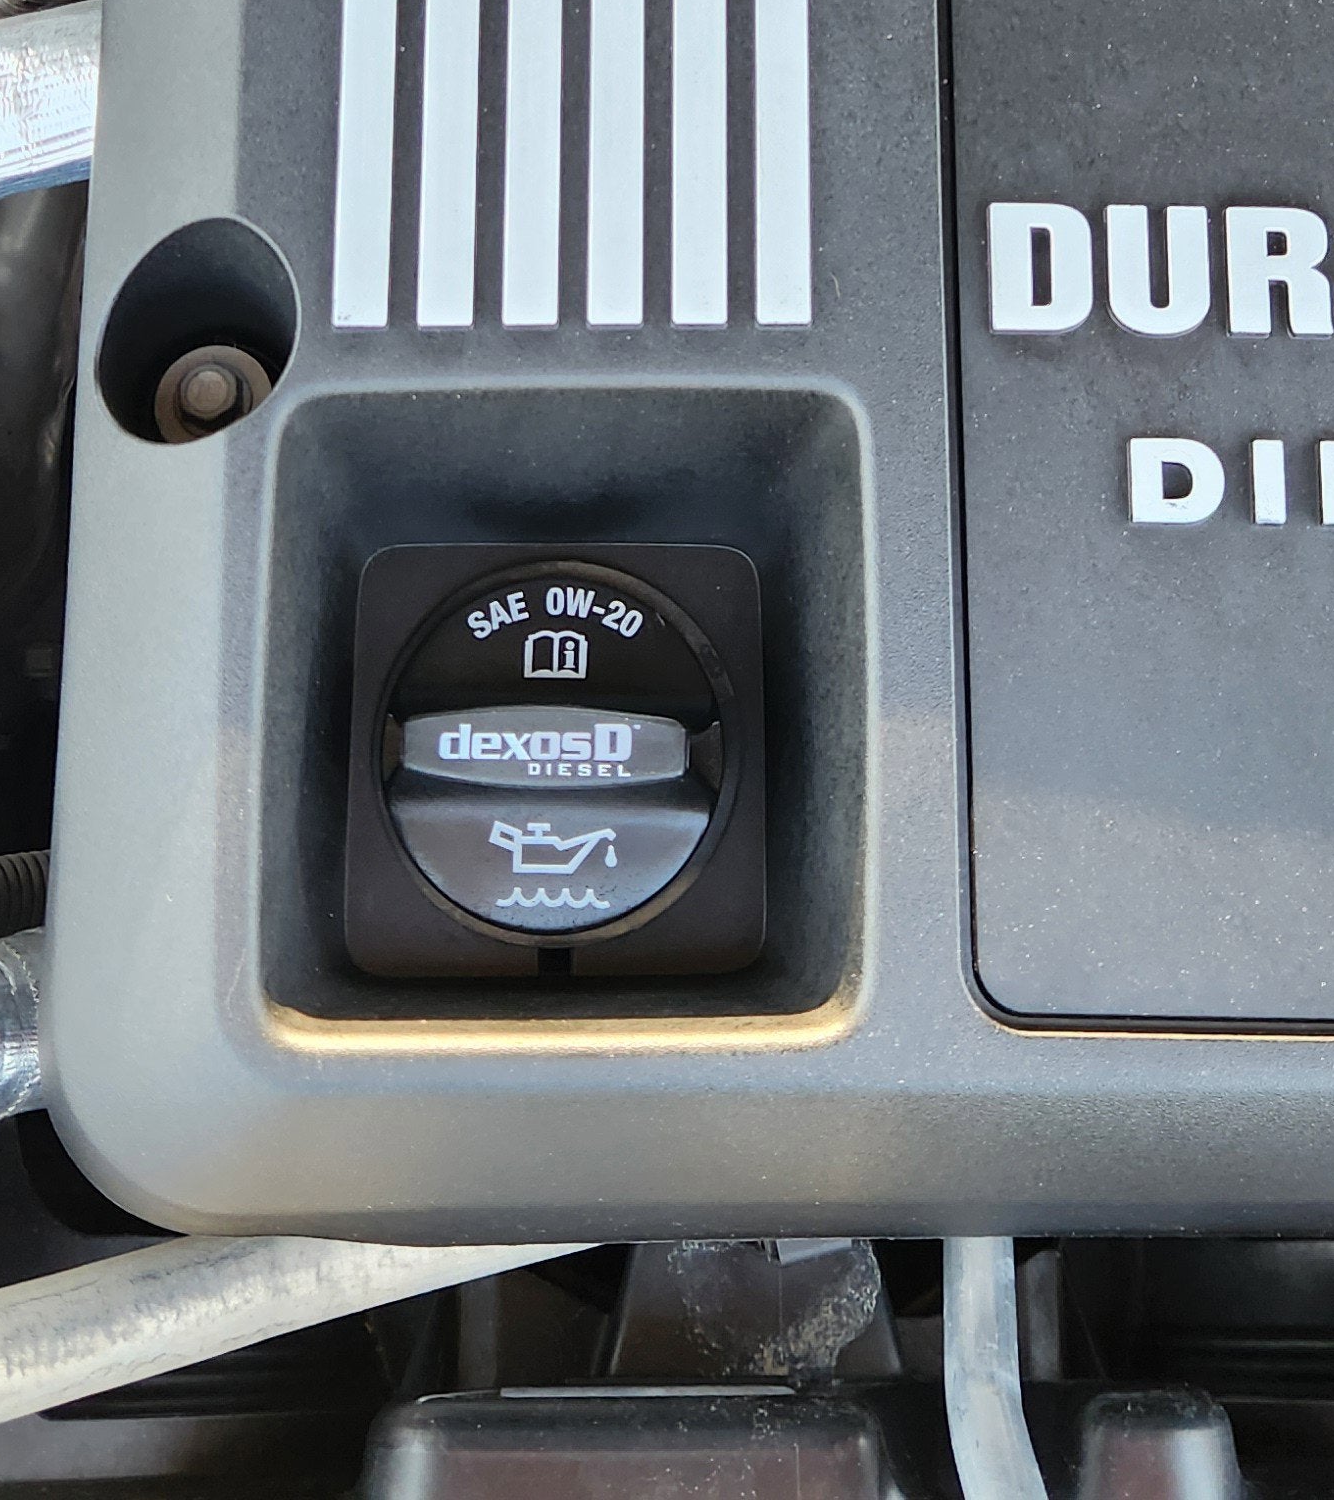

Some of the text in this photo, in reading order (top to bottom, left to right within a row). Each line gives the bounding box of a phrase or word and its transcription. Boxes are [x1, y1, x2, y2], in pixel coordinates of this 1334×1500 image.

[467, 586, 644, 639] SAE 0W-20
[438, 723, 633, 761] dexosD
[527, 762, 632, 777] DIESEL
